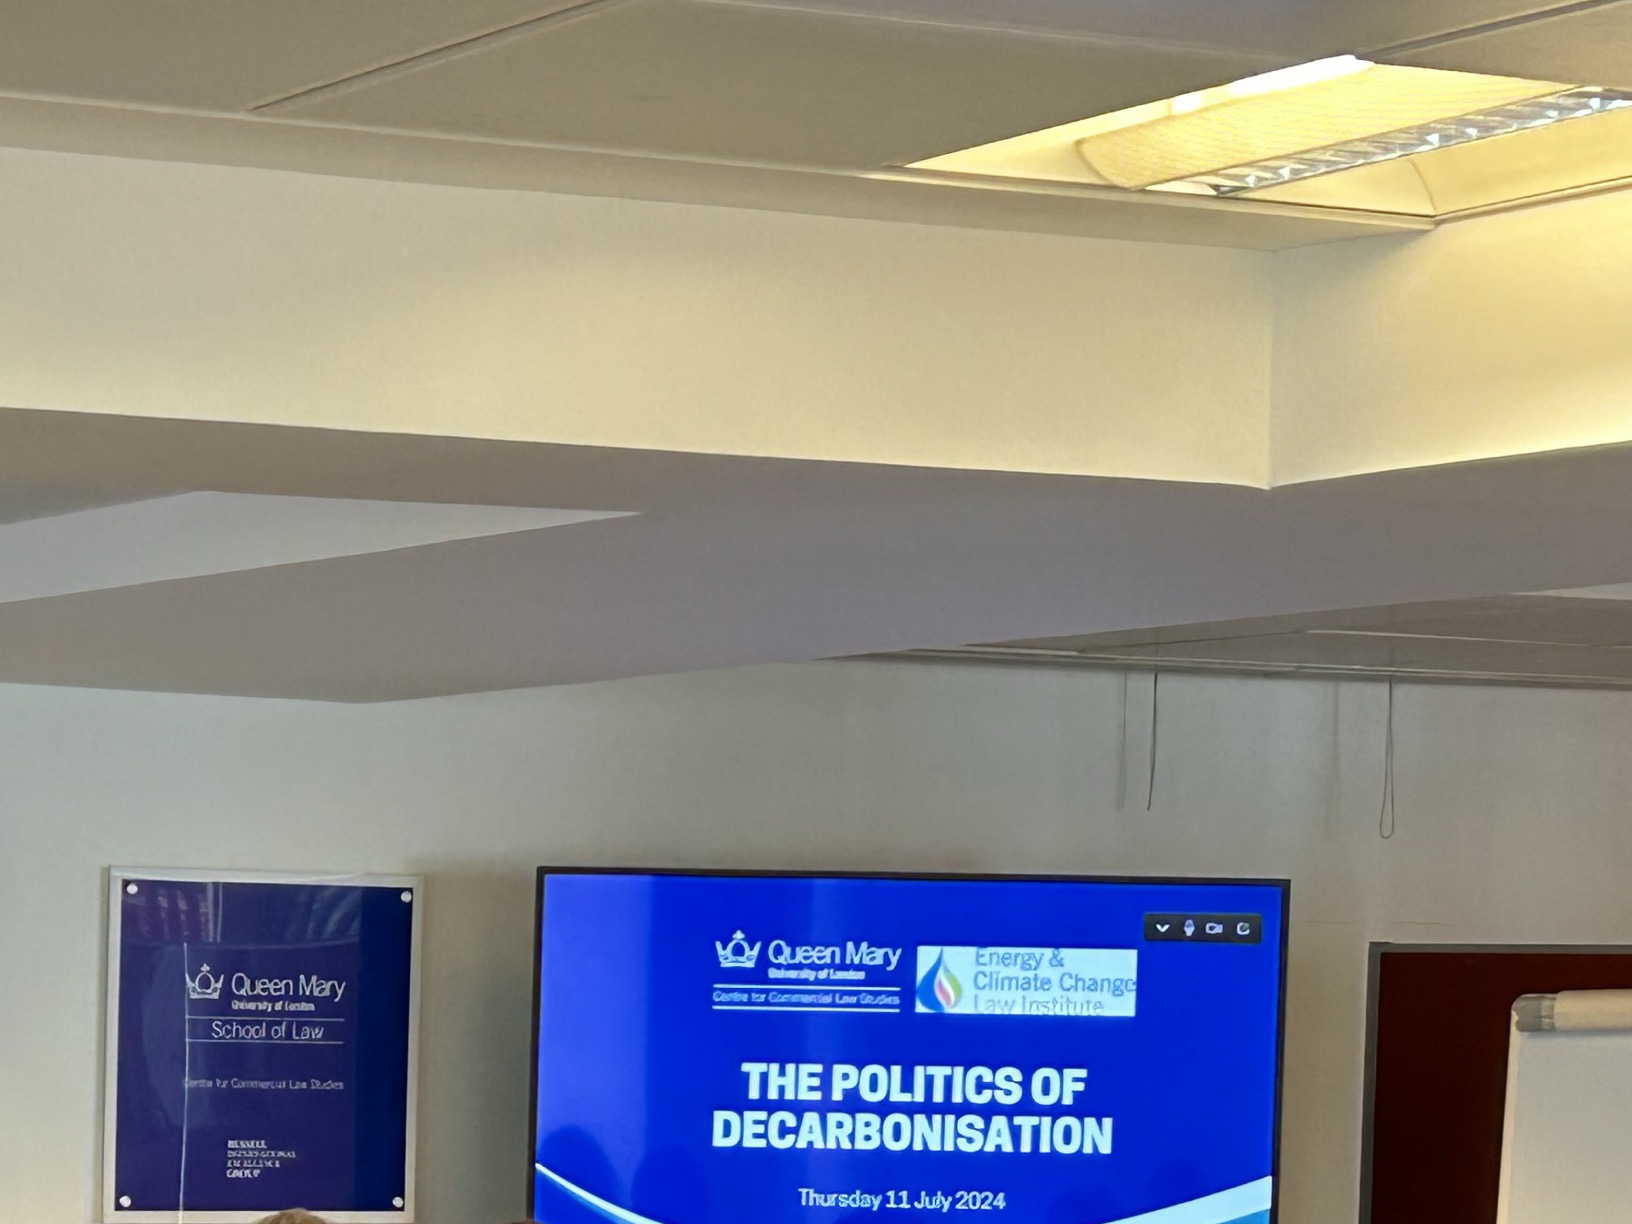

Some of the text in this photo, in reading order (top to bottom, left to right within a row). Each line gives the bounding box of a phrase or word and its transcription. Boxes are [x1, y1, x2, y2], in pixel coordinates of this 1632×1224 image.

[768, 939, 902, 971] Queen Mary
[975, 947, 1065, 971] Energy &
[231, 972, 346, 1002] Queen Mary
[973, 971, 1137, 997] Climate Change
[211, 1020, 324, 1039] School of Law
[741, 1063, 1087, 1106] THE POLITICS OF
[712, 1111, 1114, 1155] DECARBONISATION
[798, 1188, 1006, 1213] Thursday 11 July 2024
